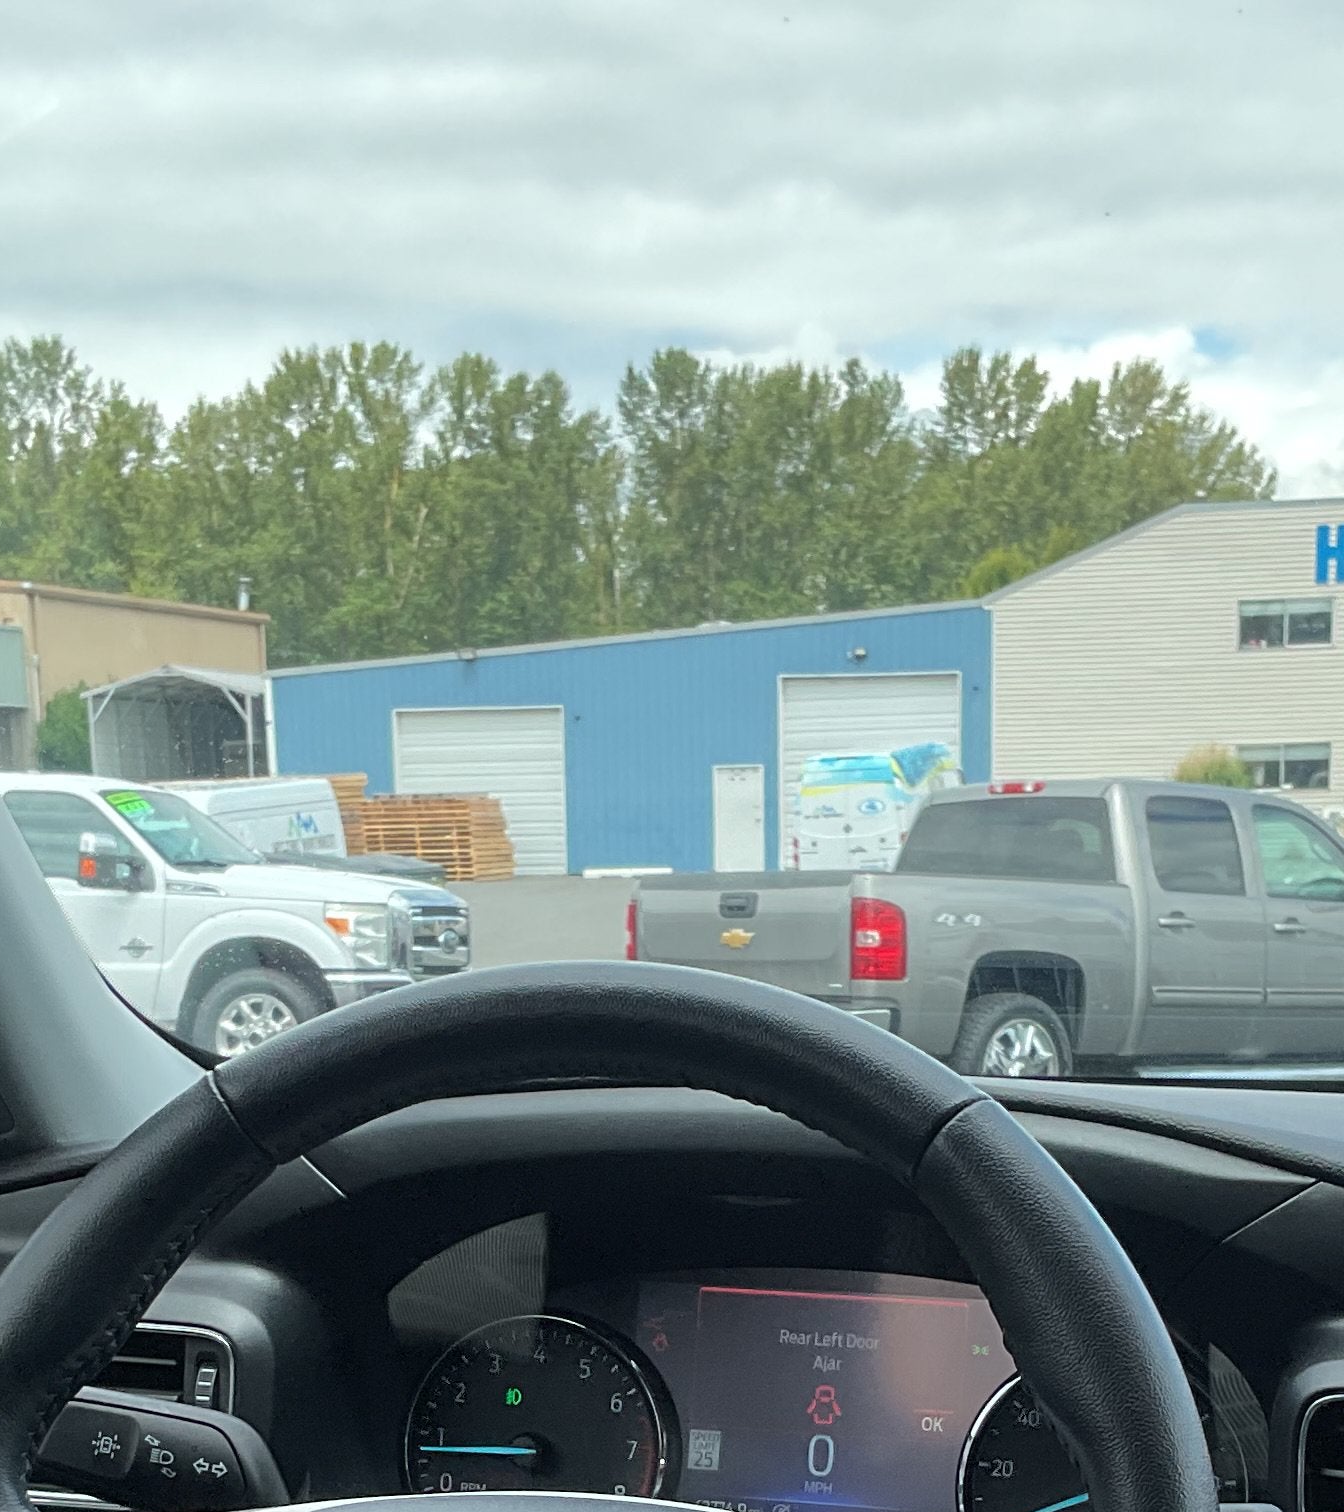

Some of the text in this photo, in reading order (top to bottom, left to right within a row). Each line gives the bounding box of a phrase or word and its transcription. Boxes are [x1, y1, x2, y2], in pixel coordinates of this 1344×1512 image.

[779, 1329, 879, 1350] Rear Left Door
[489, 1353, 503, 1375] 3
[533, 1350, 547, 1365] 4
[812, 1355, 843, 1373] Ajar
[578, 1358, 592, 1379] 5
[455, 1382, 467, 1404] 2
[609, 1393, 623, 1413] 6
[921, 1417, 944, 1433] OK
[1017, 1409, 1042, 1429] 40
[626, 1440, 639, 1460] 7
[693, 1451, 713, 1468] 25
[807, 1434, 835, 1477] 0
[991, 1459, 1014, 1478] 20
[440, 1472, 453, 1491] 0
[803, 1481, 833, 1496] MPH
